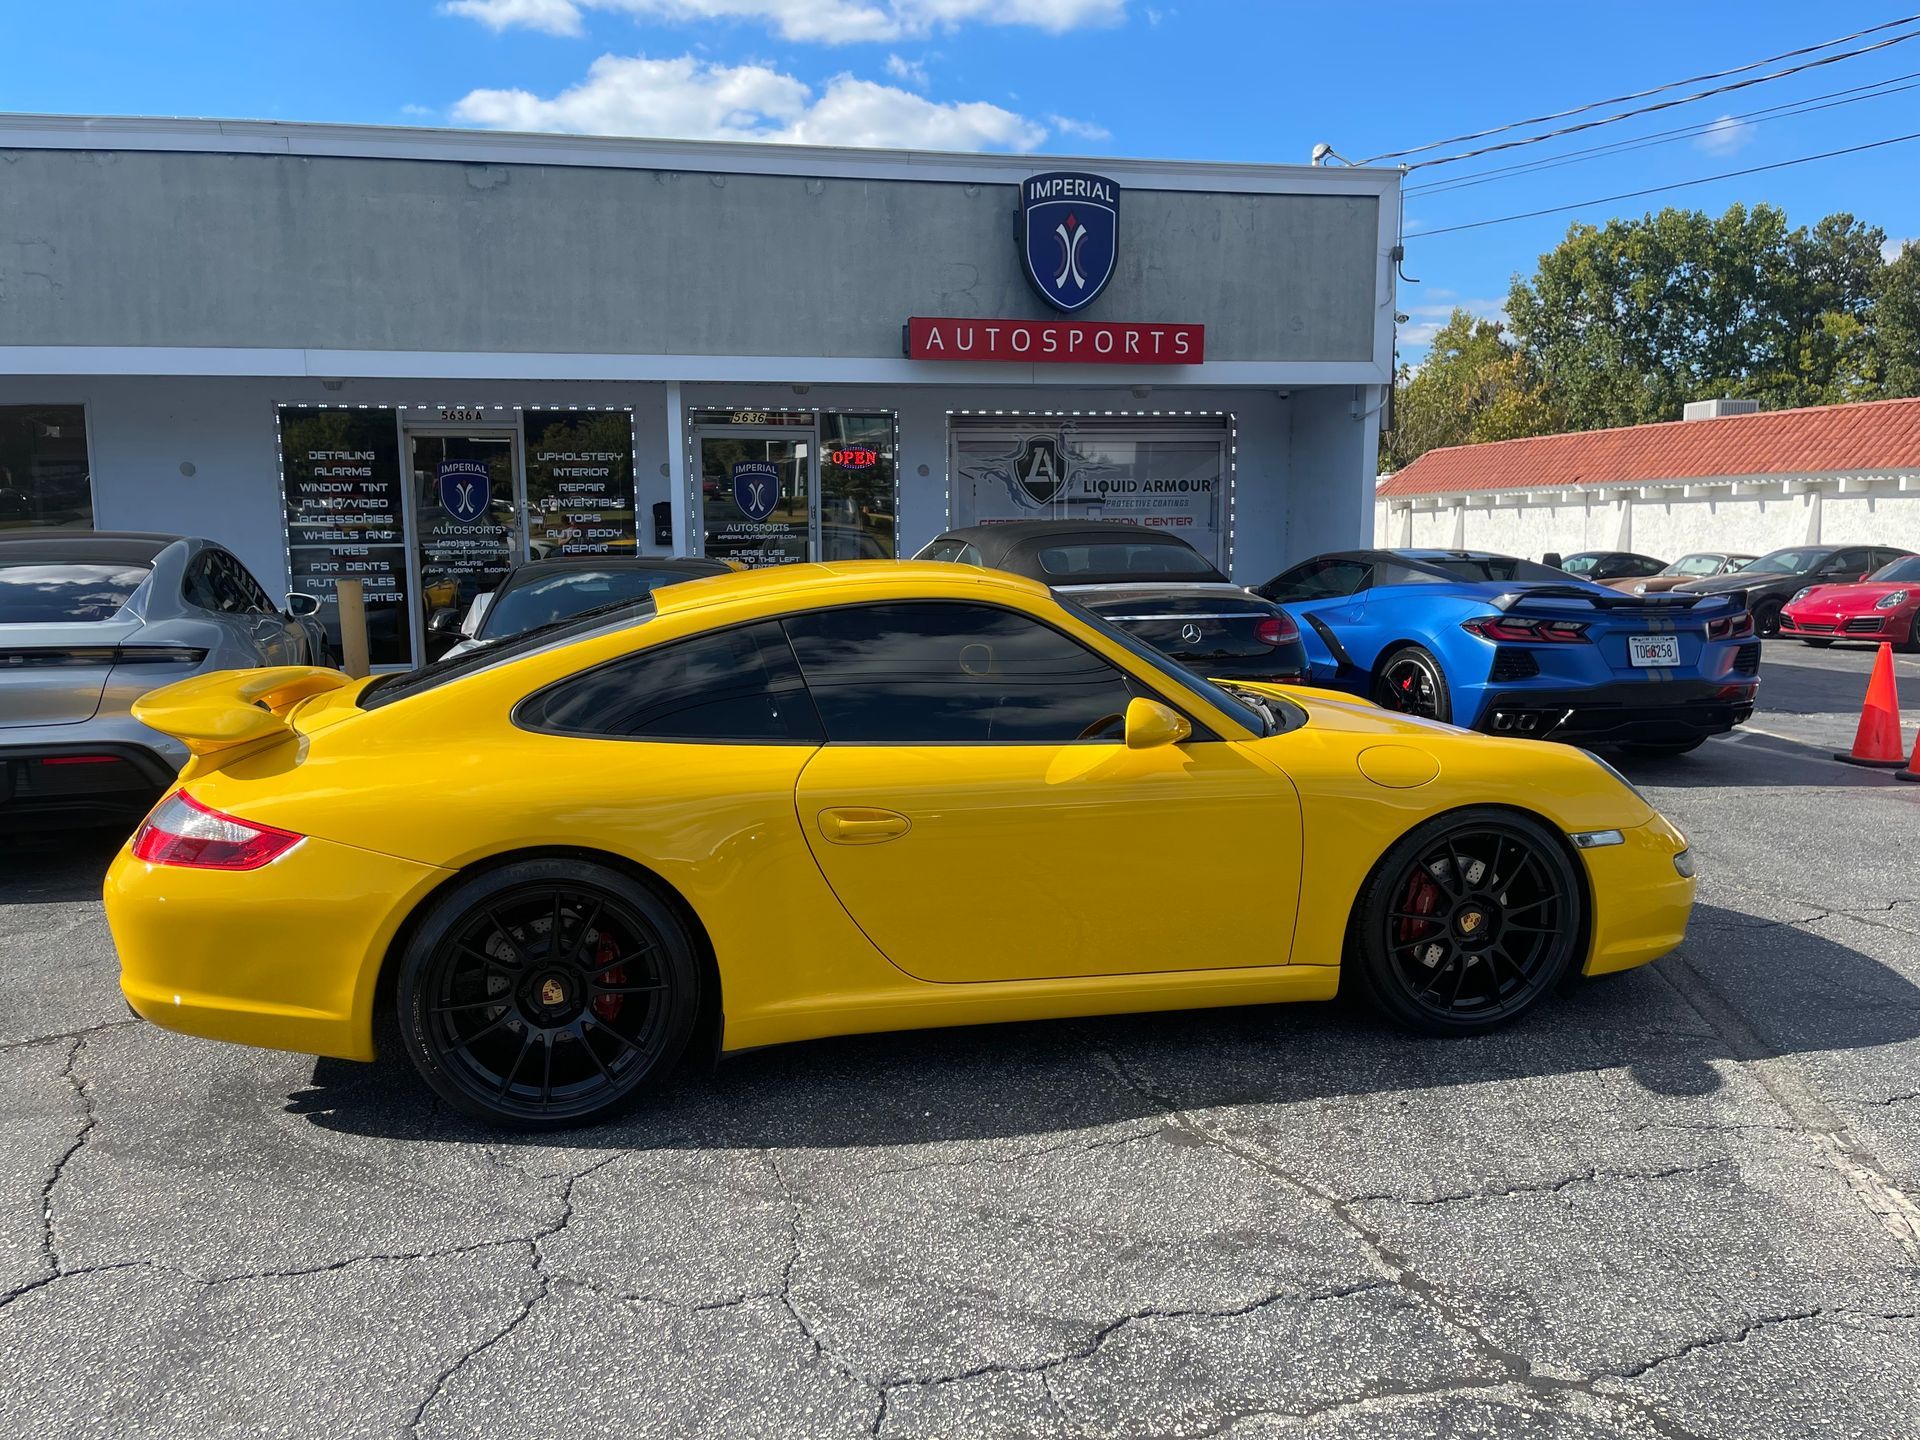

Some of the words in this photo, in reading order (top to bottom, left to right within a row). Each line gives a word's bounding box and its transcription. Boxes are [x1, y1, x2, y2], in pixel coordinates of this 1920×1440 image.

[1030, 178, 1114, 203] IMPERIAL
[926, 326, 1190, 355] AUTOSPORTS
[441, 410, 472, 421] 5636
[475, 410, 483, 420] A
[733, 412, 765, 423] 5636
[308, 451, 375, 460] DETAILING
[537, 452, 624, 461] UPHOLSTERY
[832, 451, 877, 465] OPEN
[314, 467, 372, 476] ALARMS
[441, 462, 487, 474] IMPERIAL
[553, 467, 609, 477] INTERIOR
[735, 463, 777, 474] IMPERIAL
[299, 483, 353, 492] WINDOW
[359, 483, 388, 492] TINT
[558, 483, 606, 492] REPAIR
[1083, 480, 1137, 498] LIQUID
[1142, 480, 1211, 492] ARMOUR
[302, 499, 388, 508] AUDIO/VIDEO
[540, 498, 625, 507] CONVERTIBLE
[1106, 499, 1151, 508] PROTECTIVE
[1152, 499, 1190, 507] COATINGS
[299, 514, 393, 524] ACCESSORIES
[566, 513, 601, 522] TOPS
[1144, 516, 1193, 526] CENTER
[432, 525, 503, 535] AUTOSPORTS
[726, 523, 790, 532] AUTOSPORTS
[303, 531, 359, 540] WHEELS
[365, 530, 393, 539] AND
[546, 529, 582, 538] AUTO
[587, 528, 623, 537] BODY
[330, 546, 369, 555] TIRES
[562, 544, 609, 552] REPAIR
[310, 562, 339, 571] PDR
[345, 562, 390, 571] DENTS
[307, 578, 339, 588] AUT
[361, 577, 396, 587] ALES
[362, 592, 404, 602] EATER
[1634, 644, 1673, 659] TDE8258
